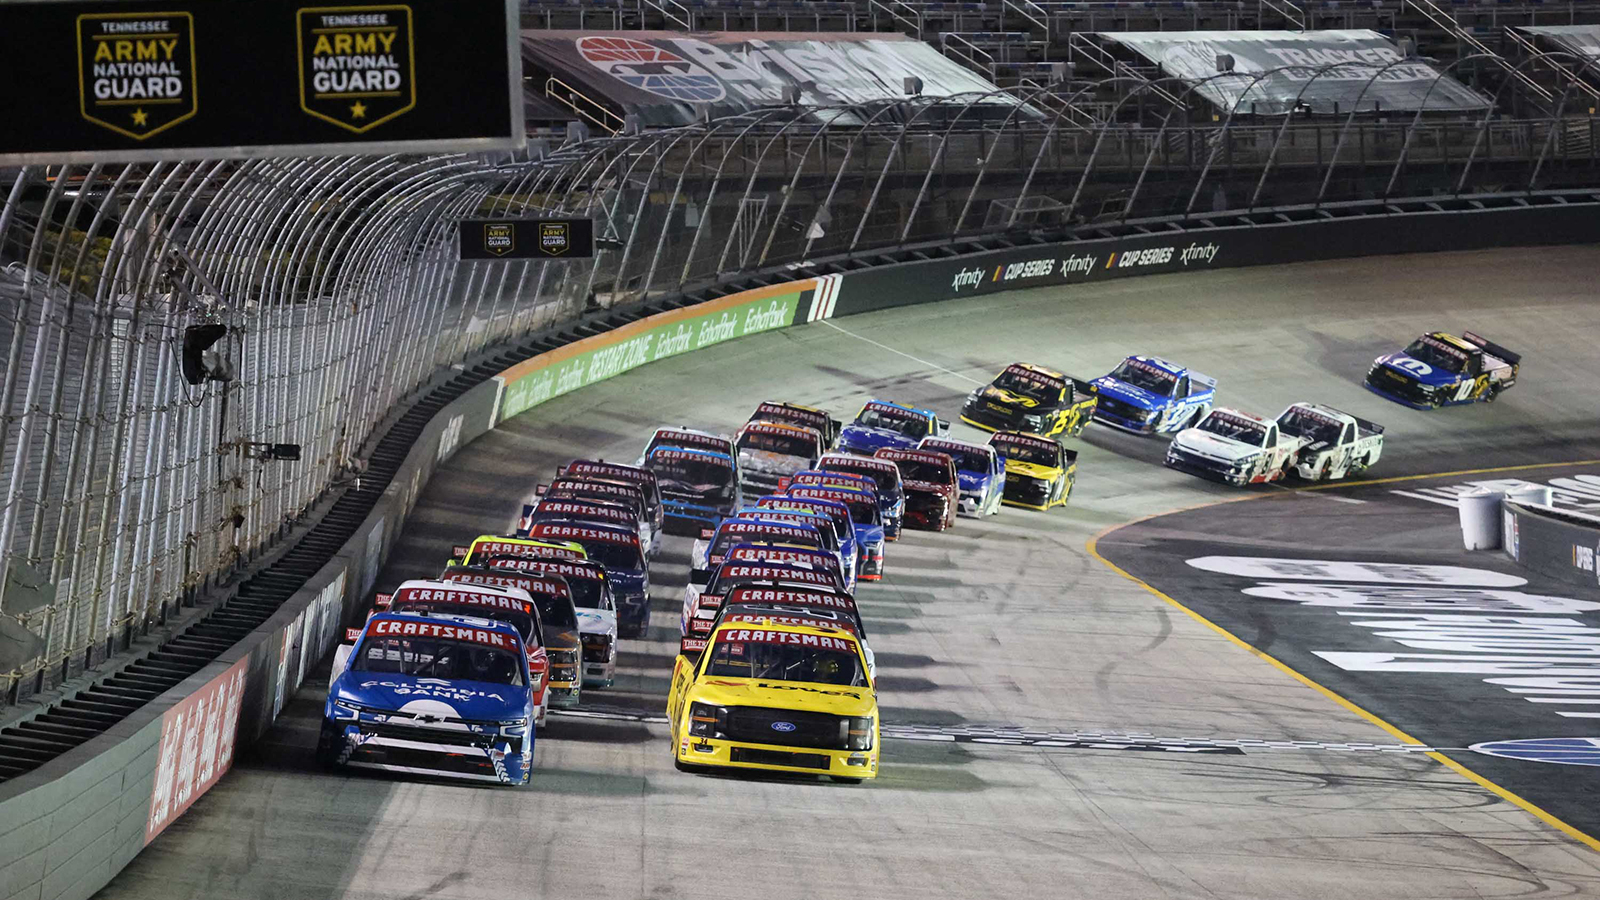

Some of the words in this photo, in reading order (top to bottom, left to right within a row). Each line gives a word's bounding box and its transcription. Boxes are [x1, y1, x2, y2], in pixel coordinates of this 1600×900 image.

[102, 21, 169, 32] TENNESSEE
[322, 15, 387, 26] TENNESSEE
[95, 40, 178, 61] ARMY
[314, 33, 396, 54] ARMY
[313, 54, 399, 71] NATIONAL
[1265, 48, 1402, 65] TRACKER
[94, 61, 181, 77] NATIONAL
[95, 77, 182, 99] GUARD
[314, 70, 400, 92] GUARD
[1119, 251, 1139, 267] CUP
[1139, 247, 1174, 265] SERIES
[1180, 242, 1220, 265] xfinity
[1004, 262, 1024, 280] CUP
[1024, 259, 1055, 278] SERIES
[1060, 253, 1098, 277] xfinity
[952, 267, 986, 291] xfinity
[623, 334, 653, 369] ZONE
[1008, 366, 1062, 389] CRAFTSMAN
[1453, 378, 1475, 401] 10
[760, 404, 826, 424] CRAFTSMAN
[869, 403, 926, 421] CRAFTSMAN
[661, 432, 725, 447] CRAFTSMAN
[750, 424, 810, 440] CRAFTSMAN
[926, 439, 986, 456] CRAFTSMAN
[994, 434, 1055, 451] CRAFTSMAN
[657, 450, 729, 466] CRAFTSMAN
[826, 457, 892, 471] CRAFTSMAN
[880, 451, 942, 465] CRAFTSMAN
[576, 464, 649, 480] CRAFTSMAN
[558, 481, 635, 497] CRAFTSMAN
[798, 475, 874, 492] CRAFTSMAN
[793, 489, 874, 504] CRAFTSMAN
[545, 503, 629, 520] CRAFTSMAN
[765, 500, 841, 515] CRAFTSMAN
[542, 525, 631, 544] CRAFTSMAN
[729, 523, 812, 538] CRAFTSMAN
[481, 542, 577, 559] CRAFTSMAN
[735, 549, 833, 568] CRAFTSMAN
[495, 560, 598, 579] CRAFTSMAN
[730, 566, 826, 584] CRAFTSMAN
[451, 574, 556, 593] CRAFTSMAN
[408, 589, 524, 611] CRAFTSMAN
[741, 589, 847, 608] CRAFTSMAN
[376, 620, 504, 646] CRAFTSMAN
[693, 620, 705, 628] THE
[684, 639, 696, 647] THE
[726, 629, 847, 650] CRAFTSMAN
[360, 680, 504, 702] COLUMBIA
[394, 687, 470, 701] BANK
